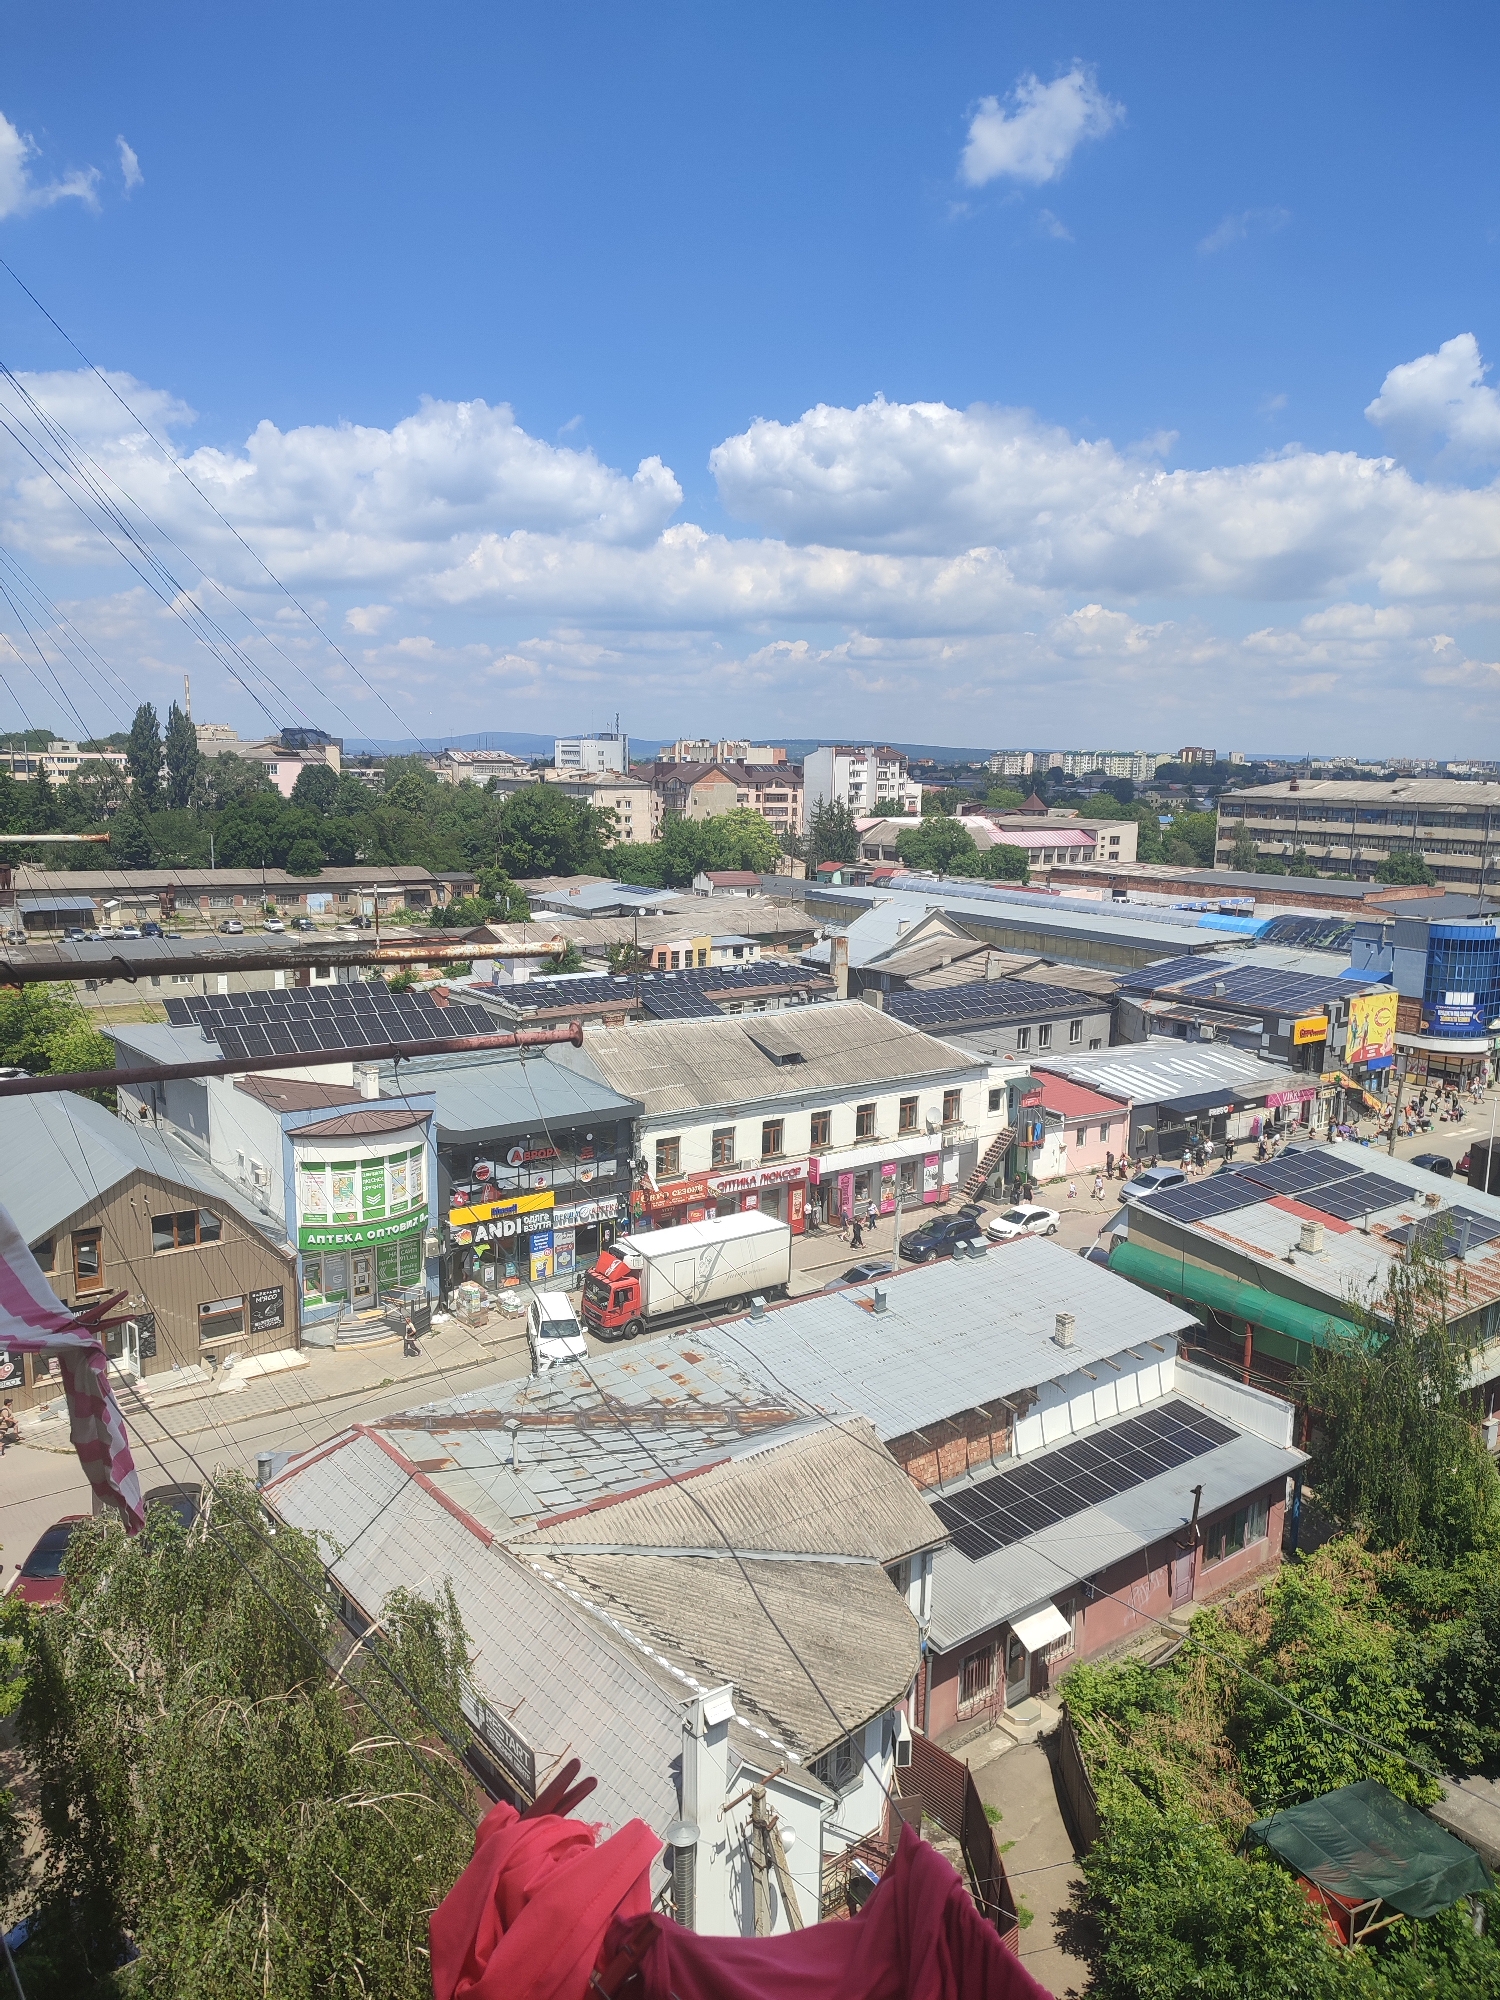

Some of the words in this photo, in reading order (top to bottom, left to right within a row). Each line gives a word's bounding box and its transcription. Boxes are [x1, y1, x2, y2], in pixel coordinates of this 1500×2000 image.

[510, 1147, 561, 1164] АВРОРА
[307, 1232, 364, 1245] АПТЕКА
[366, 1216, 419, 1240] ОПТОВИХ
[474, 1217, 522, 1243] ANDI
[523, 1220, 552, 1233] ВЗУТТЯ
[255, 1293, 278, 1304] М'ЯСО
[486, 1709, 531, 1767] RESTART
